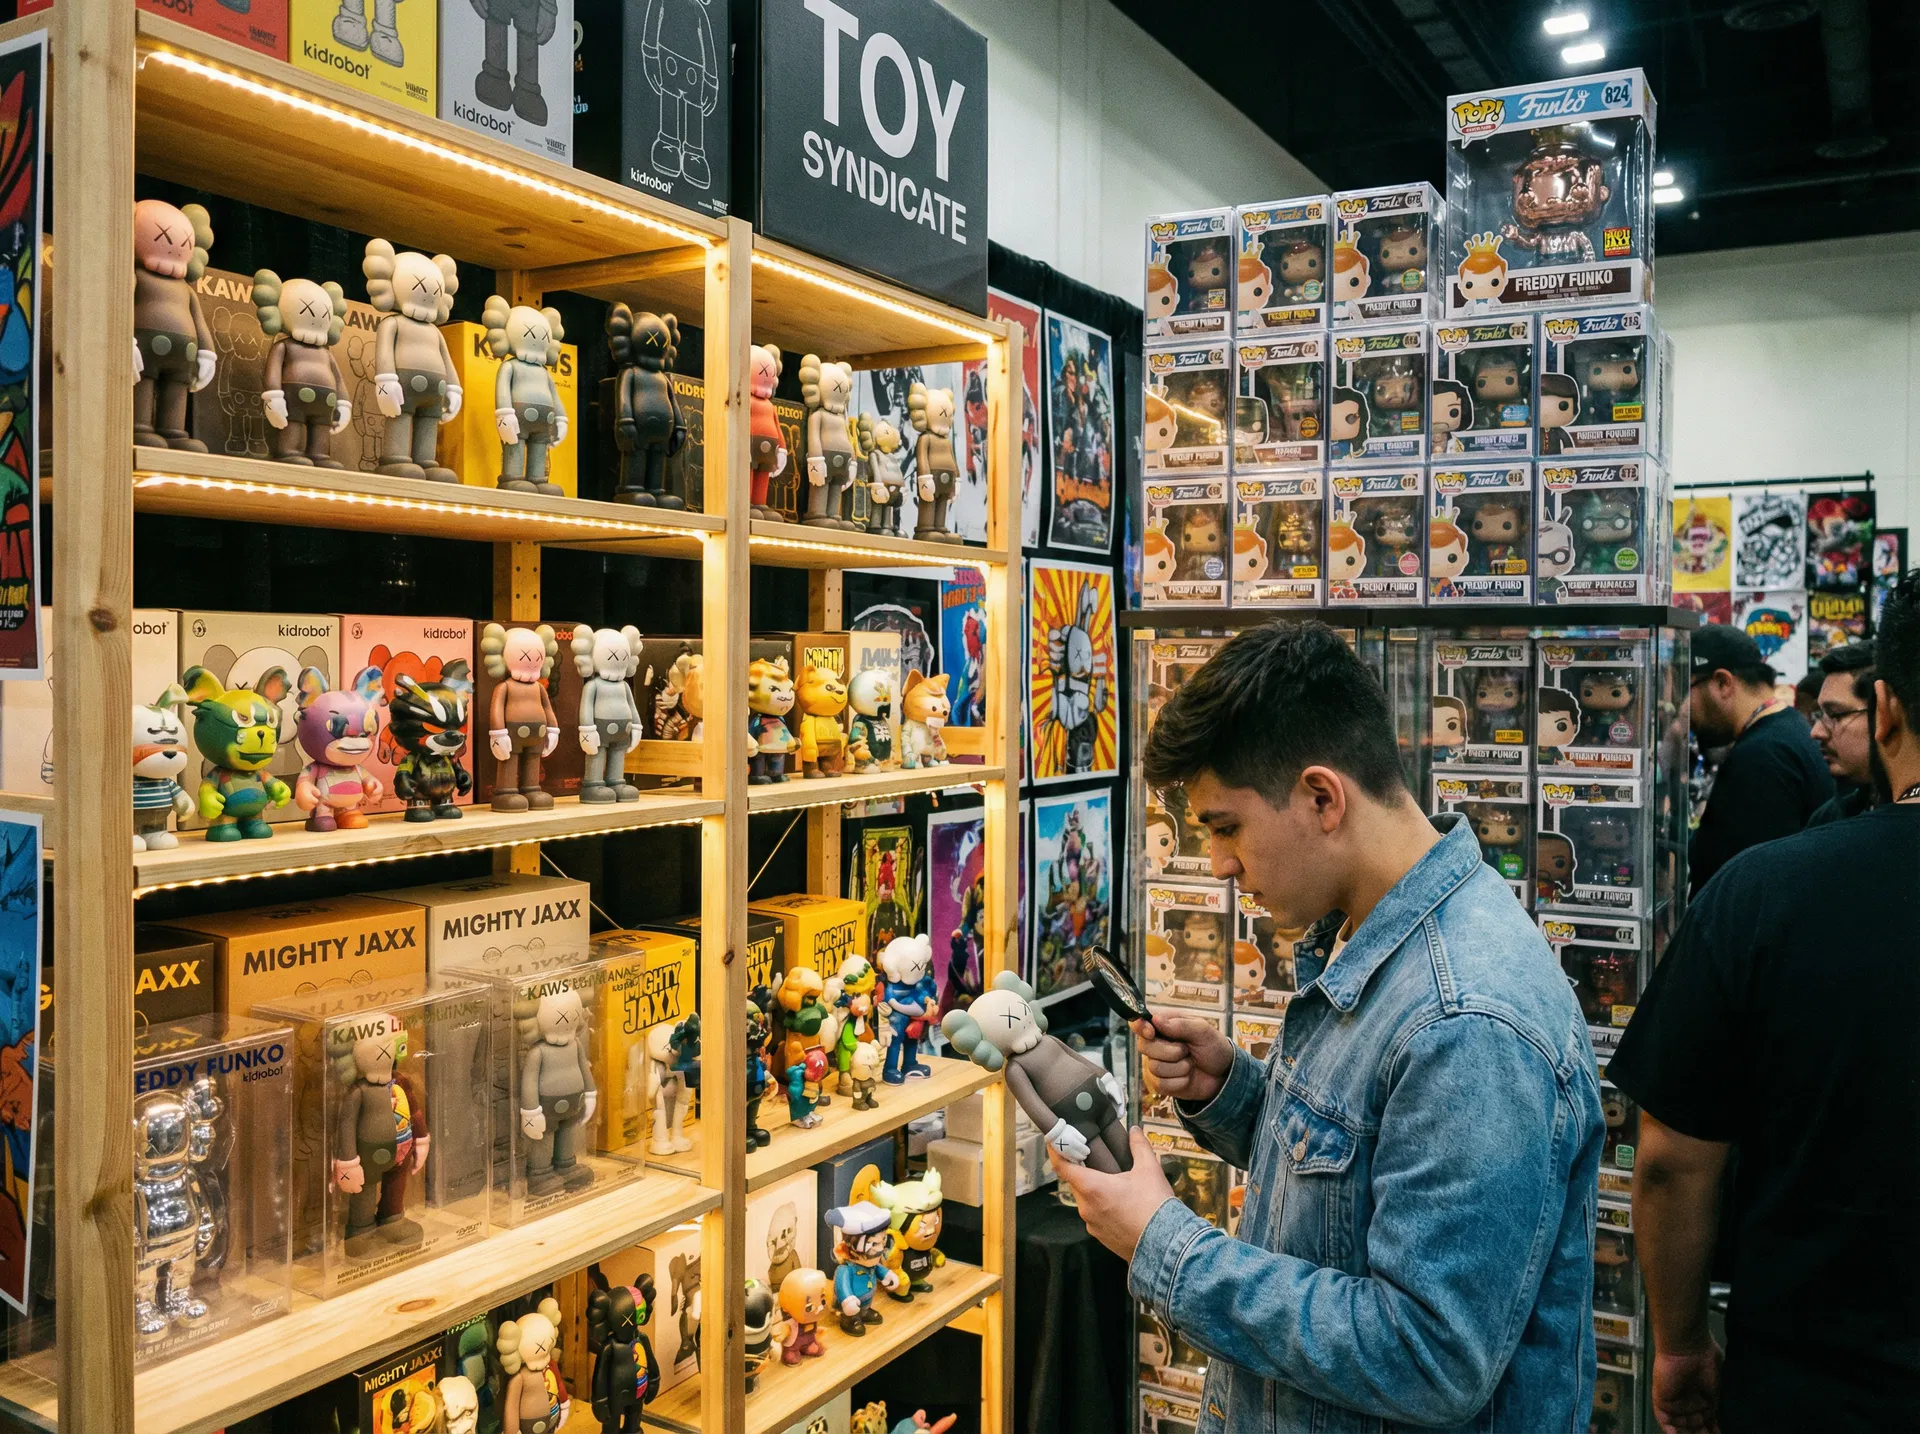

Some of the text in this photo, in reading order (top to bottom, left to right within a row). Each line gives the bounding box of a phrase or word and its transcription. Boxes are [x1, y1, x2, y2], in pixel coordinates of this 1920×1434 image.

[303, 40, 371, 80] kidrobot
[803, 0, 965, 182] TOY
[1518, 84, 1629, 119] Funko 824
[454, 101, 513, 137] kidrobot
[1452, 100, 1504, 127] POP!
[631, 167, 672, 195] kidrobot
[803, 130, 967, 245] SYNDICATE
[1516, 272, 1565, 292] FREDDY
[1569, 269, 1613, 288] FUNKO
[278, 624, 331, 638] kidrobot
[443, 898, 582, 941] MIGHTY JAXX
[814, 920, 857, 951] MIGHTY
[243, 926, 416, 976] MIGHTY JAXX
[135, 960, 201, 995] AXX
[526, 977, 571, 1001] KAWS
[623, 961, 682, 1004] MIGHTY
[623, 984, 680, 1034] JAXX
[332, 1020, 386, 1046] KAWS
[207, 1044, 285, 1078] FUNKO
[364, 1362, 408, 1393] MIGHTY
